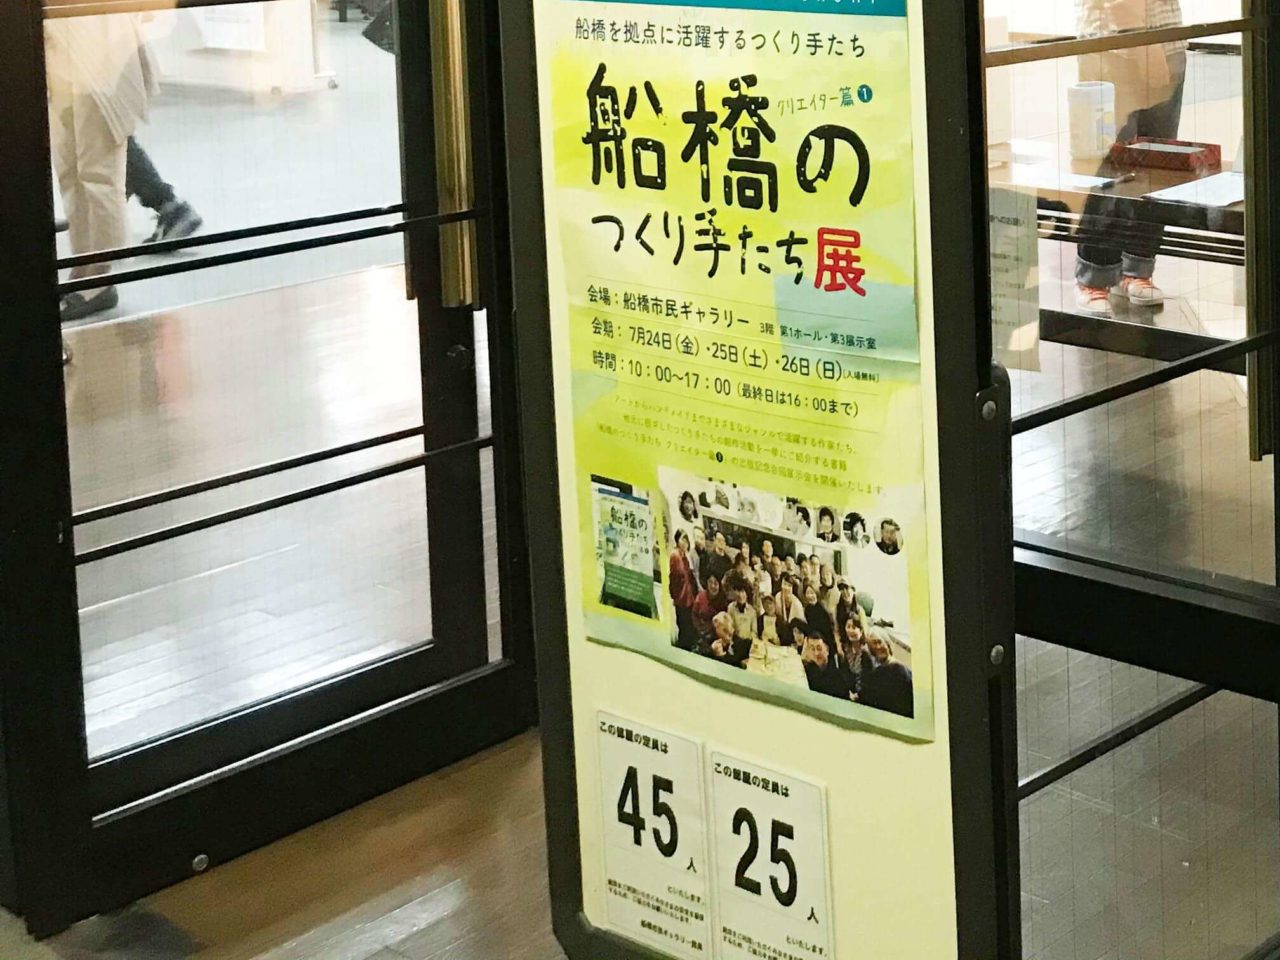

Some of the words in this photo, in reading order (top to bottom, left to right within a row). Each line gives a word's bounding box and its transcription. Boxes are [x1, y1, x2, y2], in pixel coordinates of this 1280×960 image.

[574, 16, 866, 59] 船橋を拠点に活躍するつくり手たち
[581, 62, 871, 214] 船橋の
[591, 207, 868, 297] つくり手たち展
[616, 765, 679, 858] 45
[686, 857, 697, 874] 人
[732, 806, 798, 907] 25
[807, 906, 819, 925] 人
